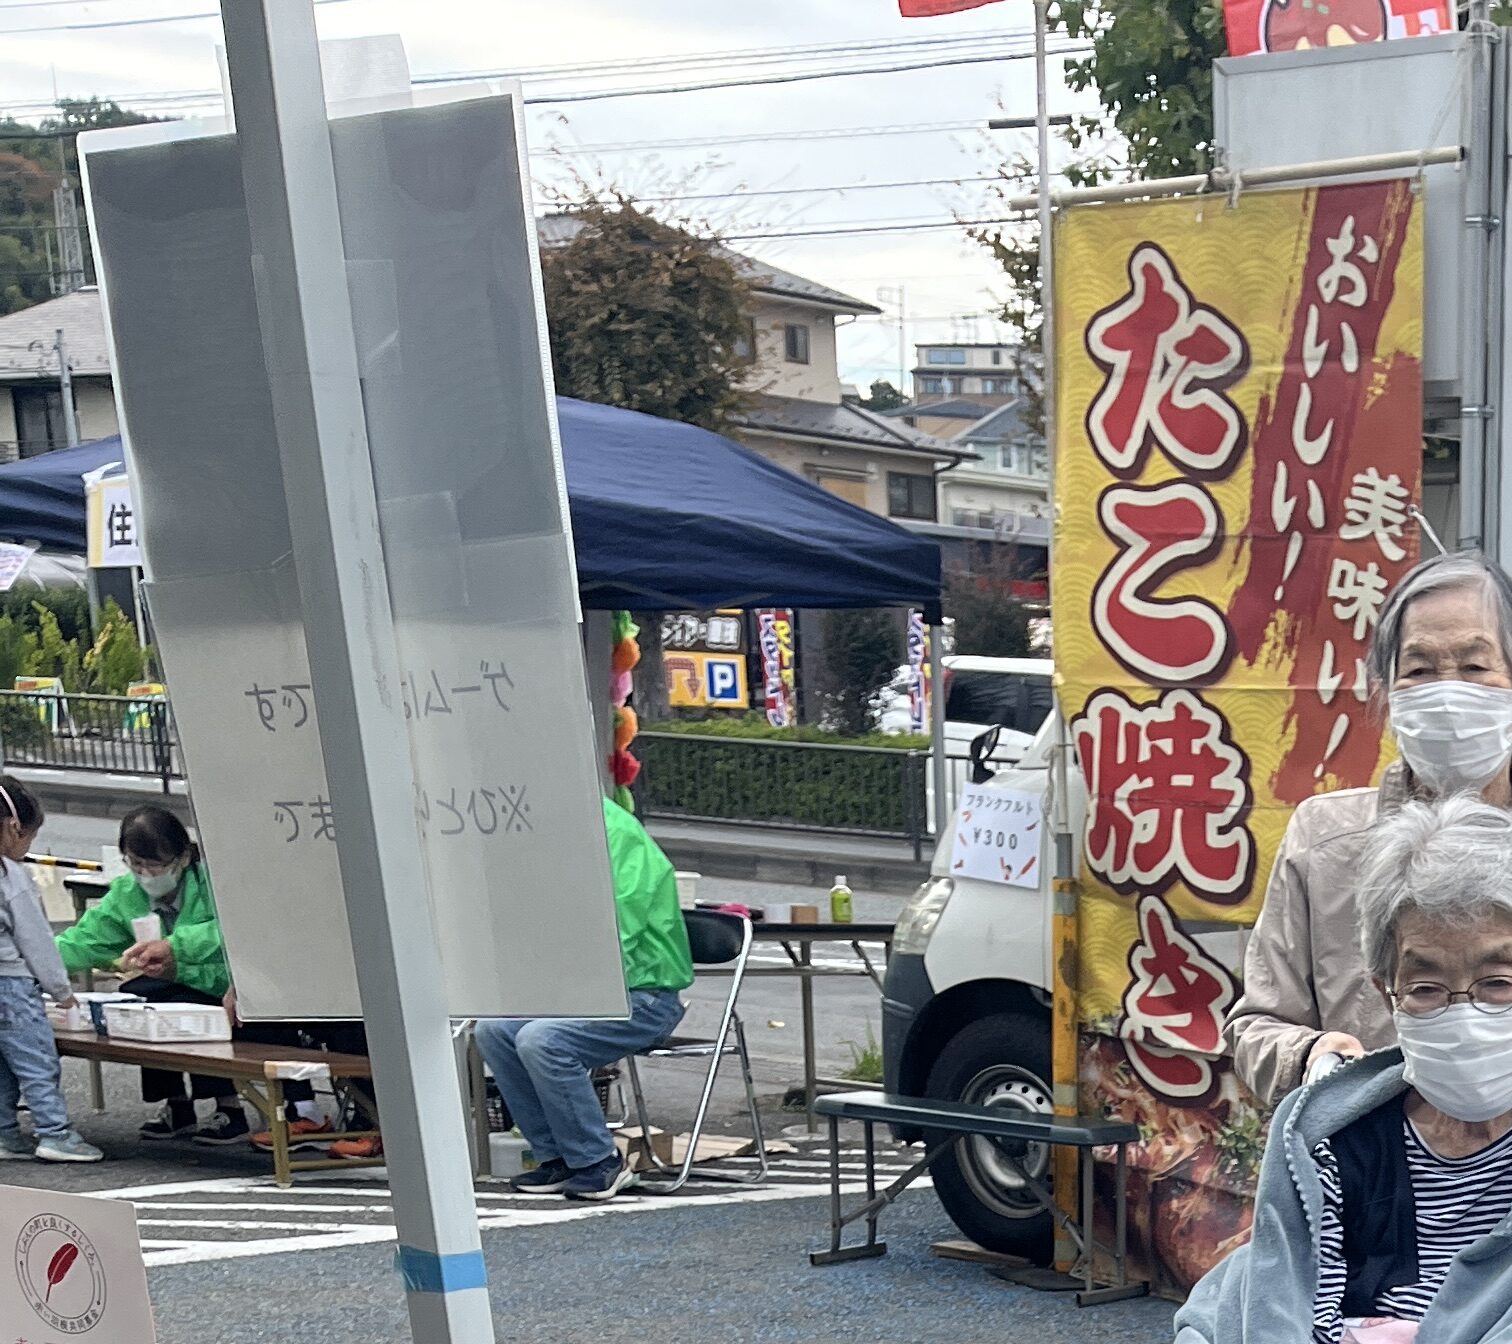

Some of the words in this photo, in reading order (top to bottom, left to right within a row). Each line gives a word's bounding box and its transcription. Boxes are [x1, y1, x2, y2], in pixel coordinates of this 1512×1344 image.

[712, 664, 734, 696] P
[1071, 243, 1252, 1099] たこ焼き
[966, 794, 1034, 815] フランクフルト
[973, 827, 1018, 850] ¥300
